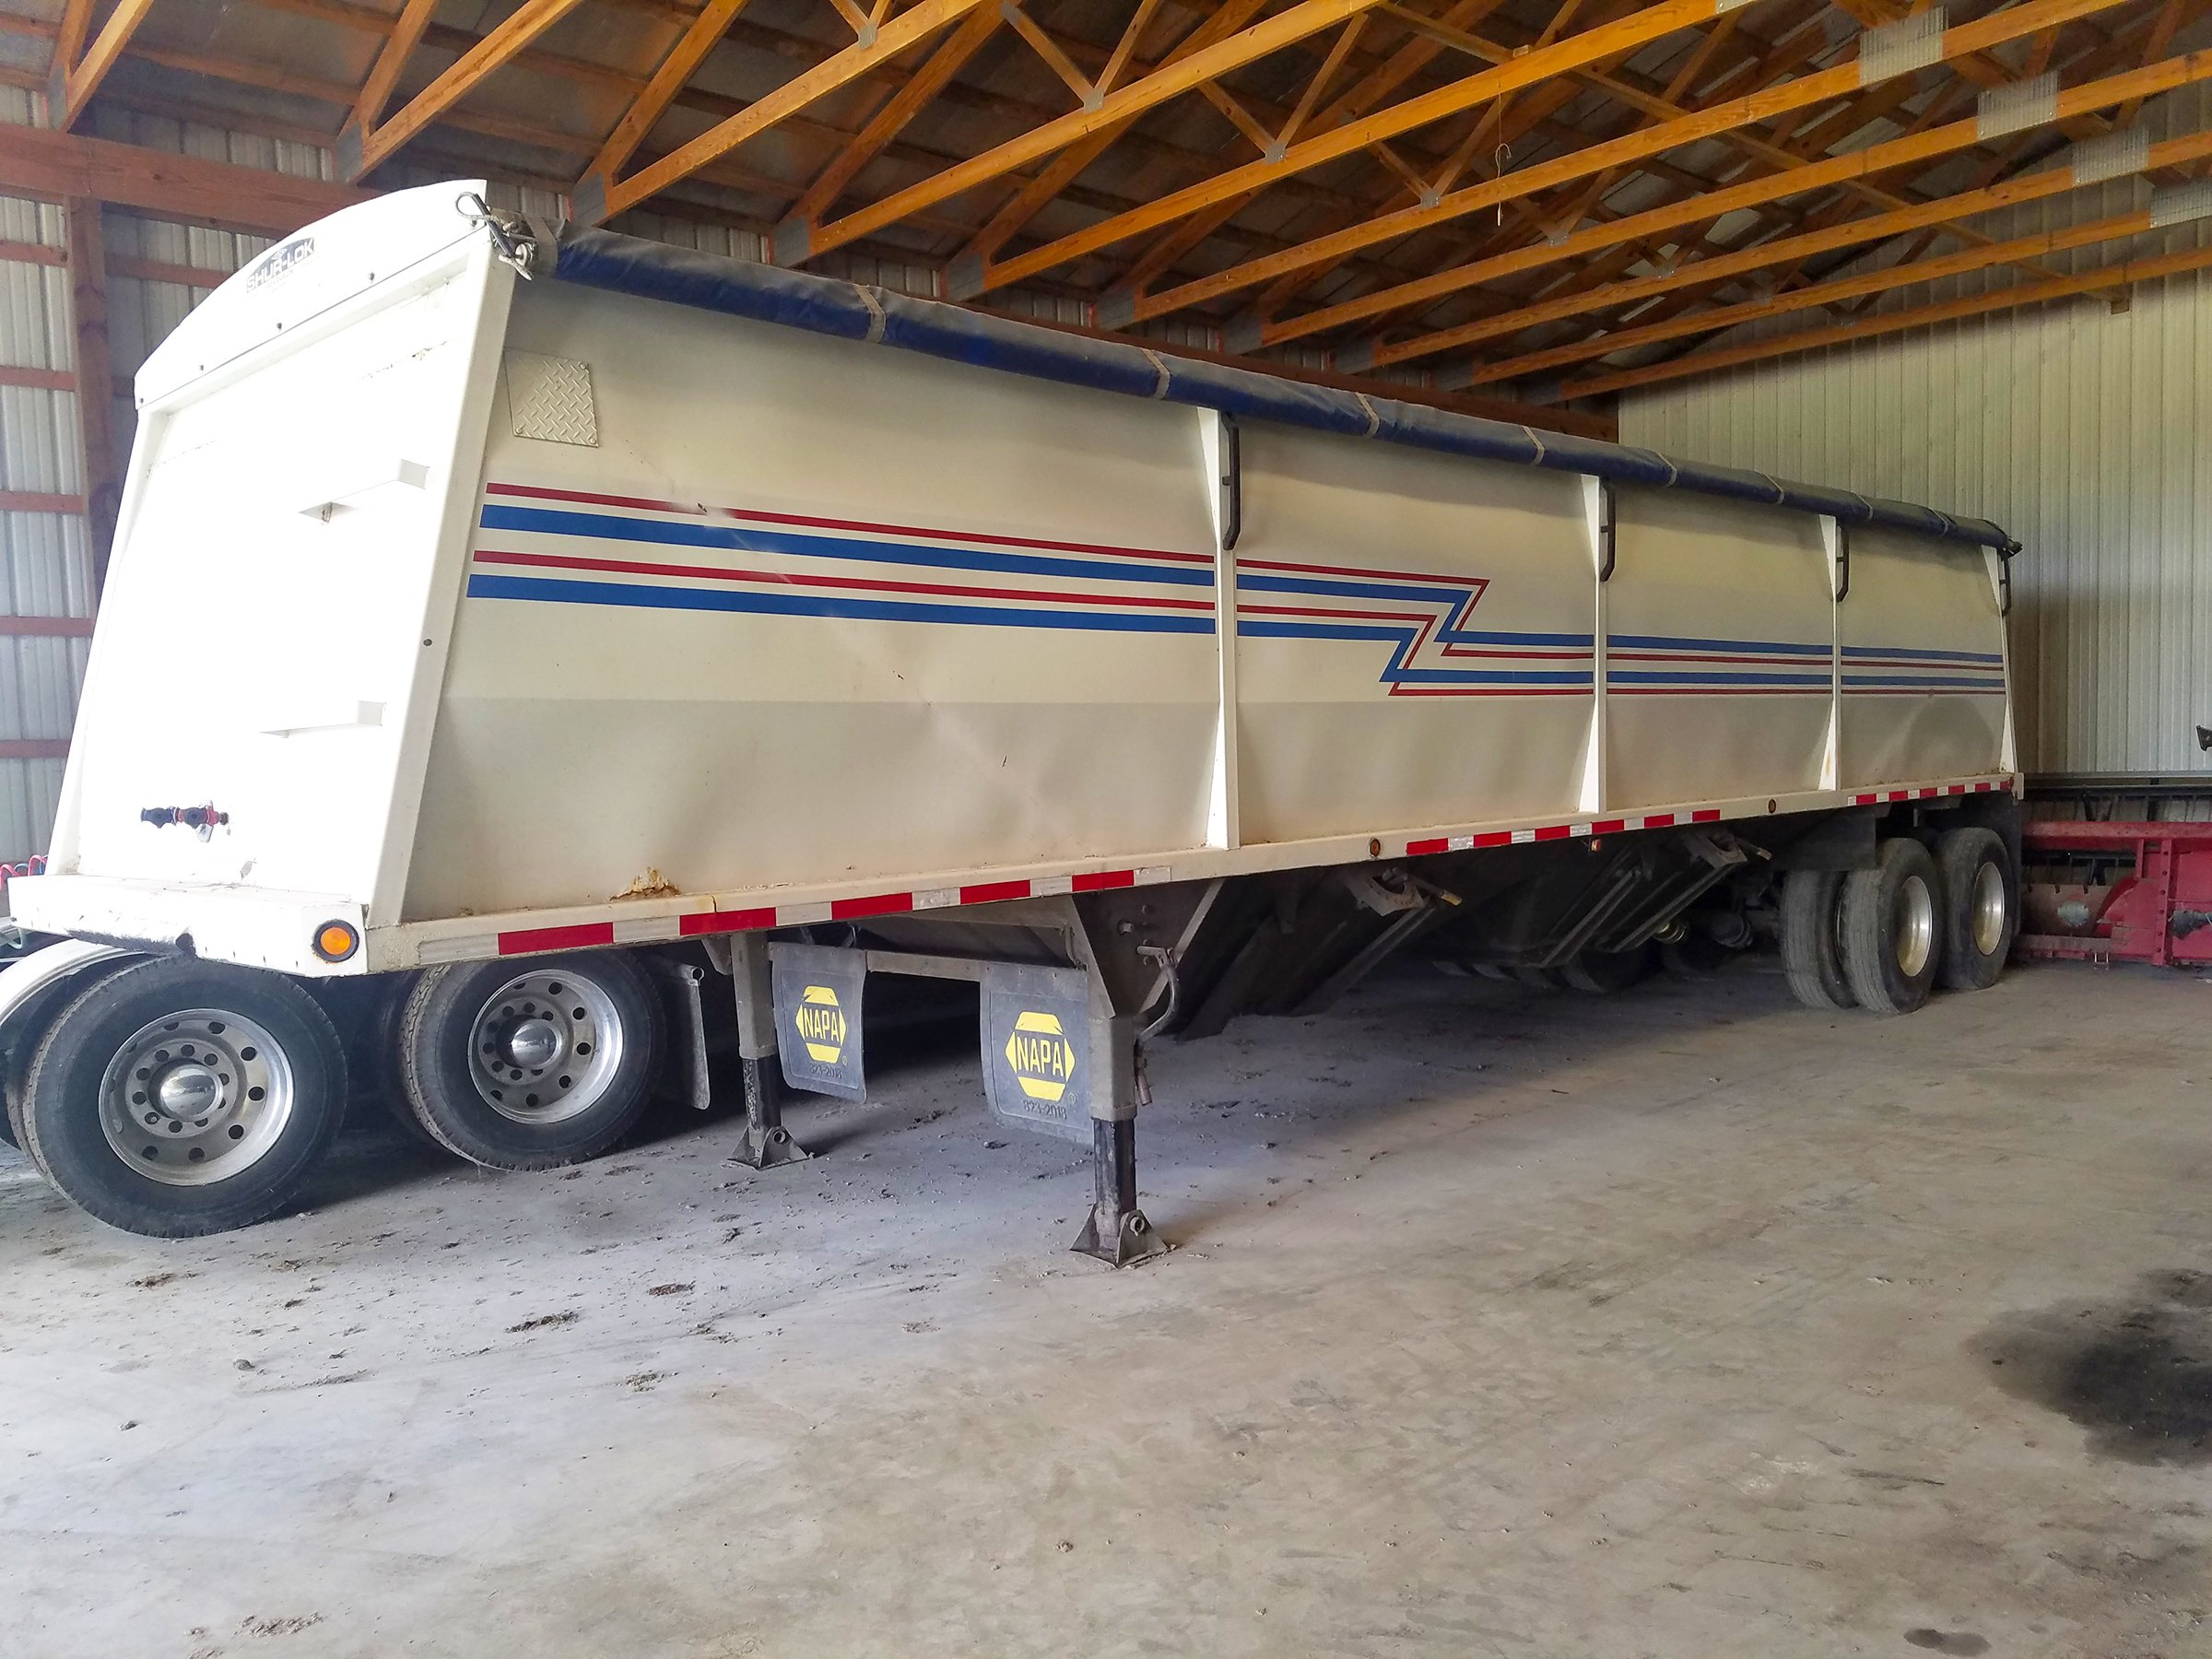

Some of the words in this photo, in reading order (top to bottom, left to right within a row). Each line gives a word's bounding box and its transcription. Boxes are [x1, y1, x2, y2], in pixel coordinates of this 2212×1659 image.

[246, 238, 314, 291] SHUR-LOK
[804, 1008, 840, 1042] NAPA
[1017, 1036, 1065, 1077] NAPA
